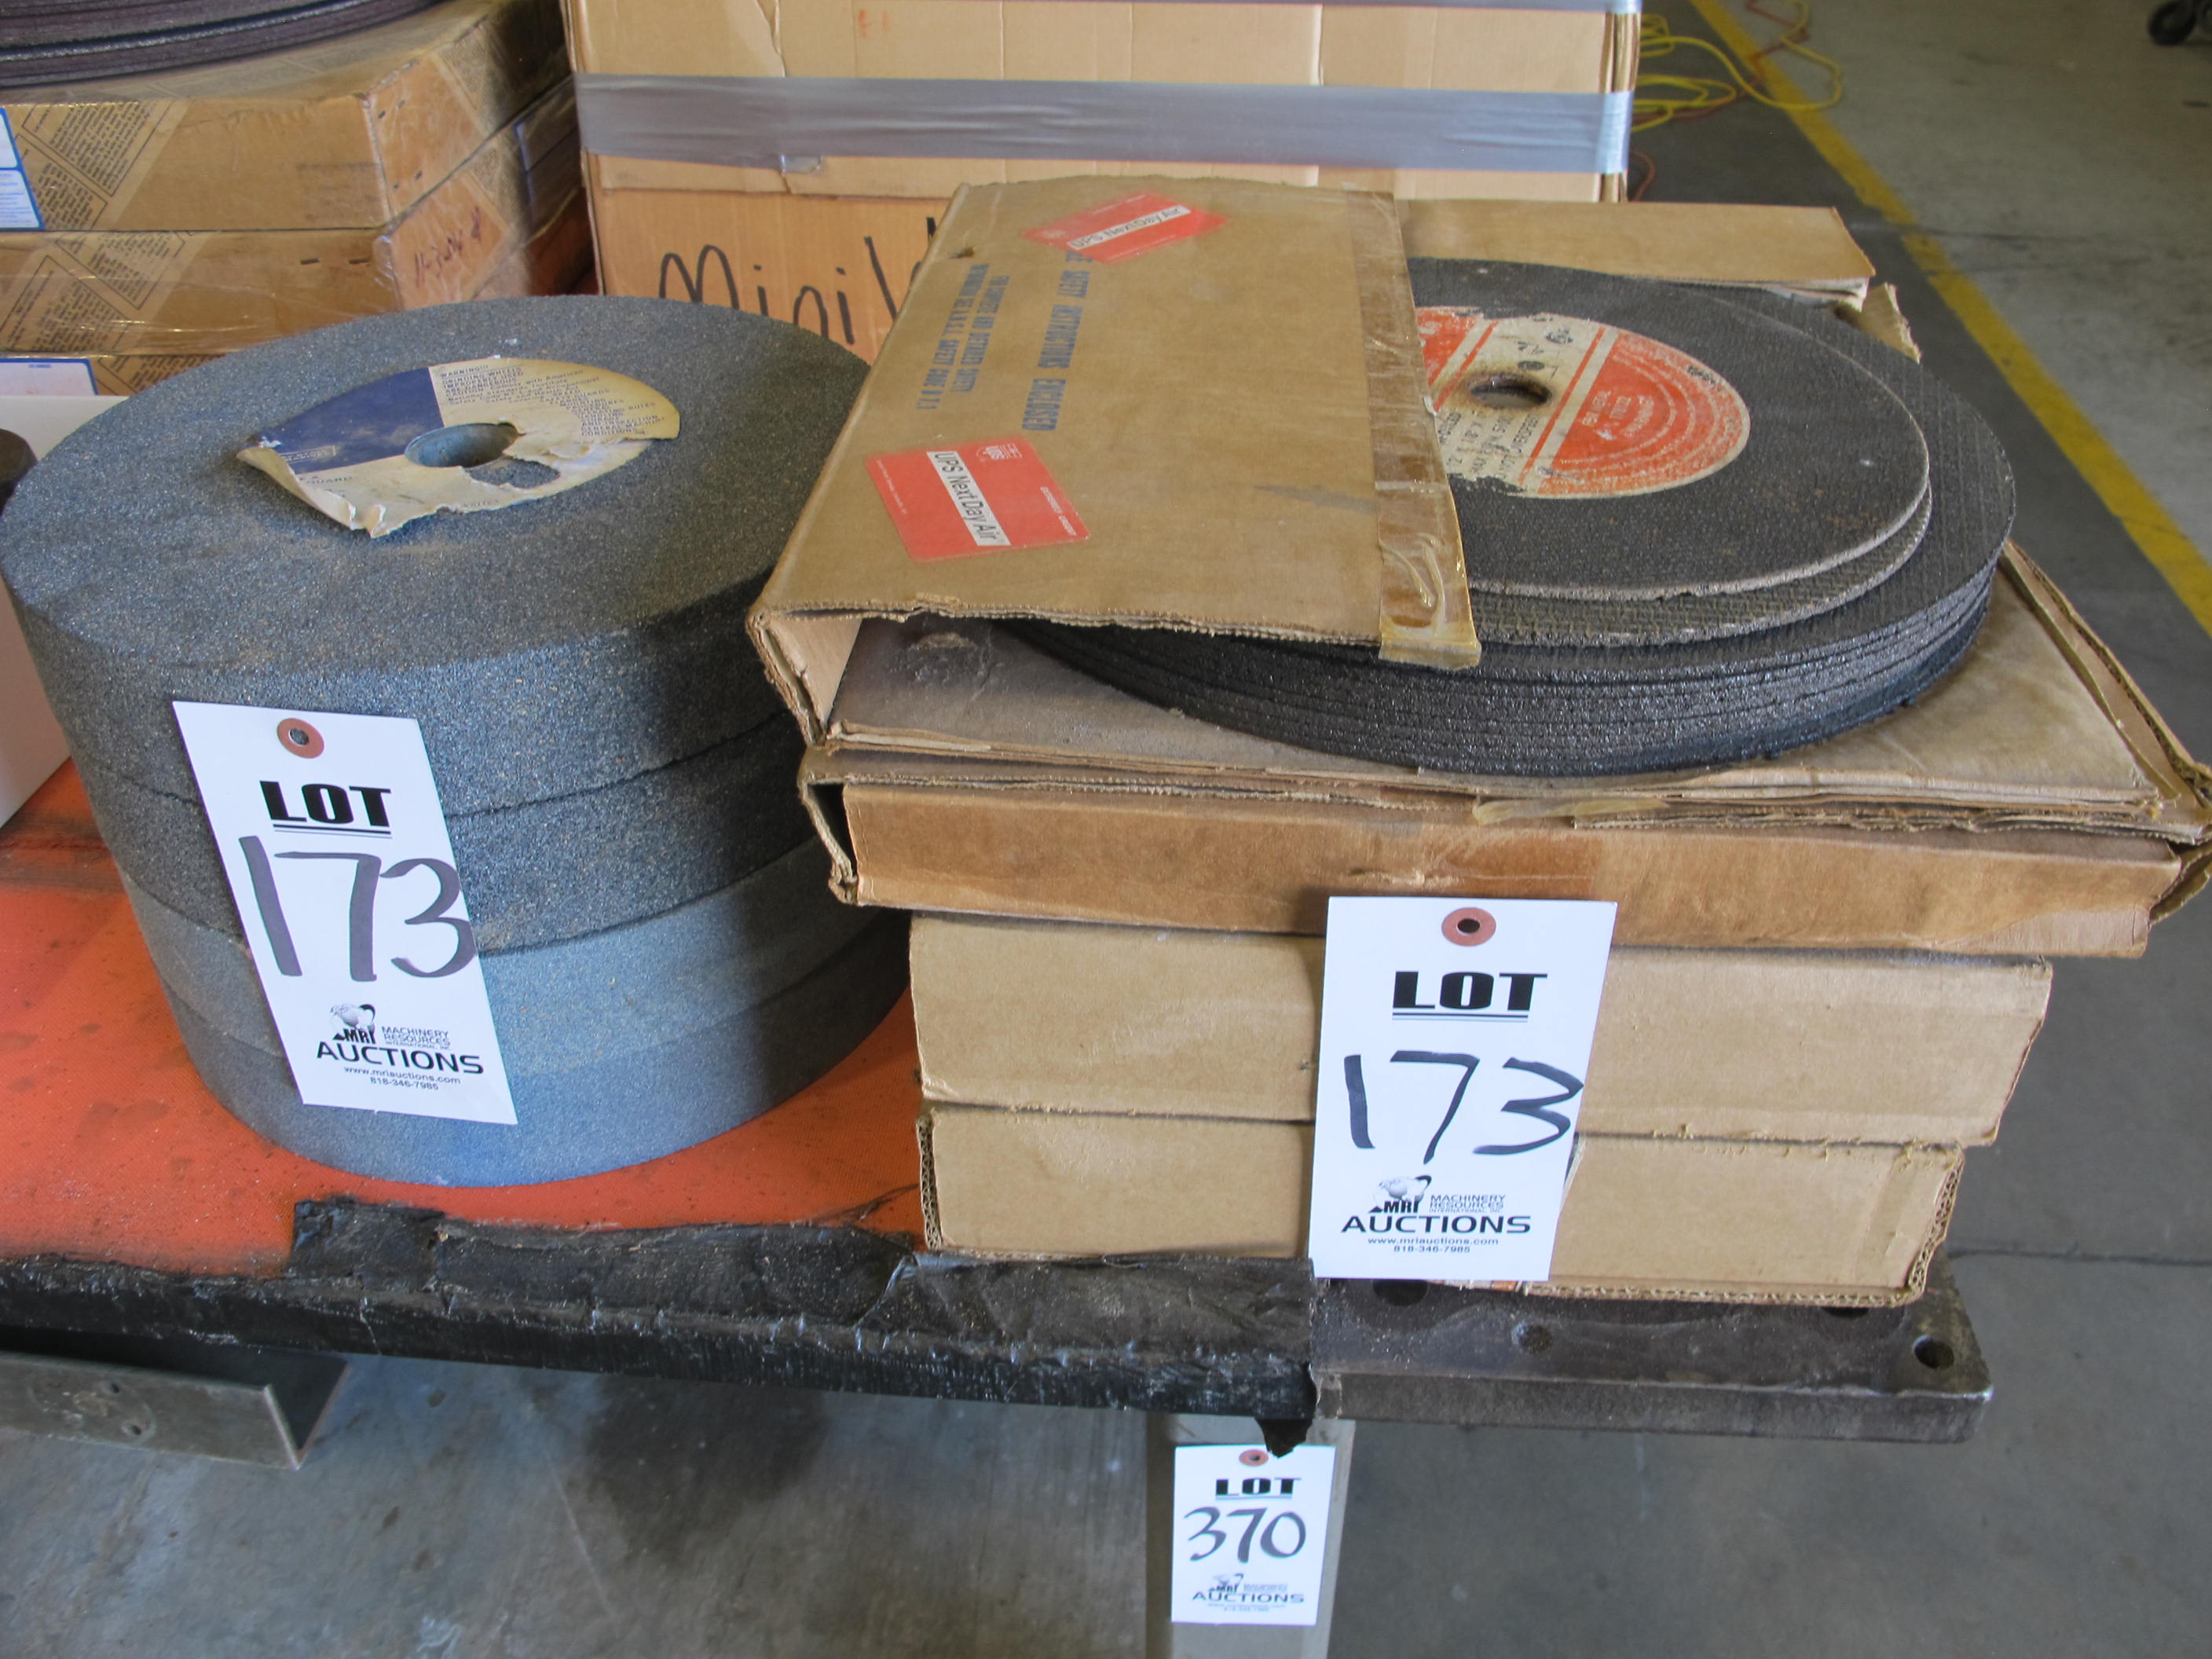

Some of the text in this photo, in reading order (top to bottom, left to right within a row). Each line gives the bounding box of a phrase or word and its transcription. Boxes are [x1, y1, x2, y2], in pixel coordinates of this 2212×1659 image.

[934, 452, 1001, 540] UPS Next Day Air
[259, 780, 391, 827] LOT
[239, 835, 478, 982] 173
[1393, 971, 1547, 1011] LOT
[382, 1026, 449, 1038] MACHINERY
[384, 1035, 451, 1046] RESOURCES
[317, 1041, 484, 1075] AUCTIONS
[344, 1066, 460, 1085] www.mriauctions.com
[370, 1077, 439, 1091] 818-346-7985
[1344, 1050, 1584, 1165] 173
[1383, 1200, 1420, 1214] MRI
[1430, 1194, 1506, 1203] MACHINERY
[1341, 1215, 1532, 1234] AUCTIONS
[1368, 1237, 1499, 1246] www.mriauctions.com
[1393, 1245, 1470, 1254] 818-346-7985
[1216, 1477, 1302, 1496] LOT
[1184, 1506, 1306, 1563] 370
[1192, 1591, 1304, 1603] AUCTIONS
